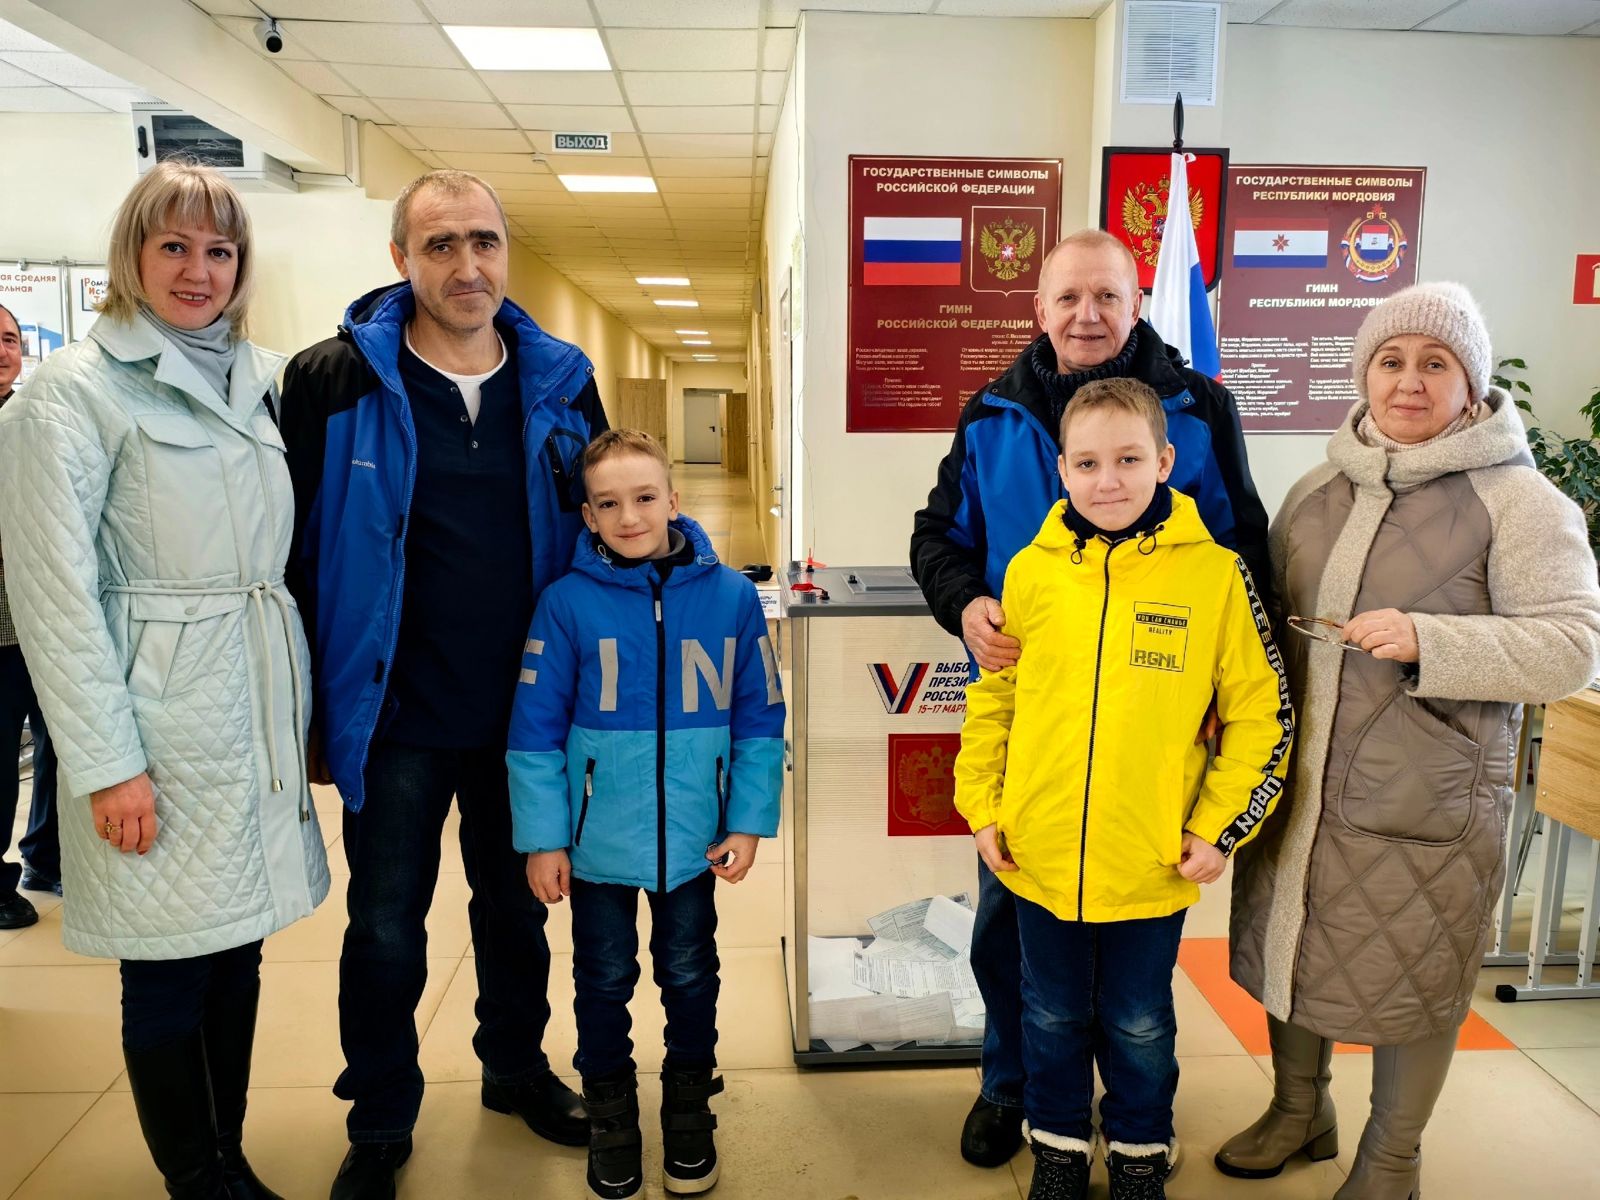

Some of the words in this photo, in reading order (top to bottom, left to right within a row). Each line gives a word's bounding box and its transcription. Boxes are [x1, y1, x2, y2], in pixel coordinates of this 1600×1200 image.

[557, 136, 606, 149] ВЫХОД
[863, 167, 984, 179] ГОСУДАРСТВЕННЫЕ
[987, 169, 1049, 179] СИМВОЛЫ
[1236, 176, 1352, 187] ГОСУДАРСТВЕННЫЕ
[1355, 177, 1413, 188] СИМВОЛЫ
[876, 182, 958, 193] РОССИЙСКОЙ
[961, 183, 1035, 195] ФЕДЕРАЦИИ
[1253, 191, 1329, 201] РЕСПУБЛИКИ
[1332, 192, 1396, 202] МОРДОВИЯ
[14, 273, 57, 283] средняя
[1305, 284, 1339, 293] ГИМН
[1249, 298, 1325, 308] РЕСПУБЛИКИ
[939, 304, 972, 314] ГИМН
[877, 317, 958, 329] РОССИЙСКОЙ
[960, 319, 1034, 330] ФЕДЕРАЦИИ
[1148, 626, 1173, 635] REALITY
[1134, 649, 1180, 669] RGNL
[942, 703, 967, 713] МАРТ
[1235, 776, 1283, 834] URBN
